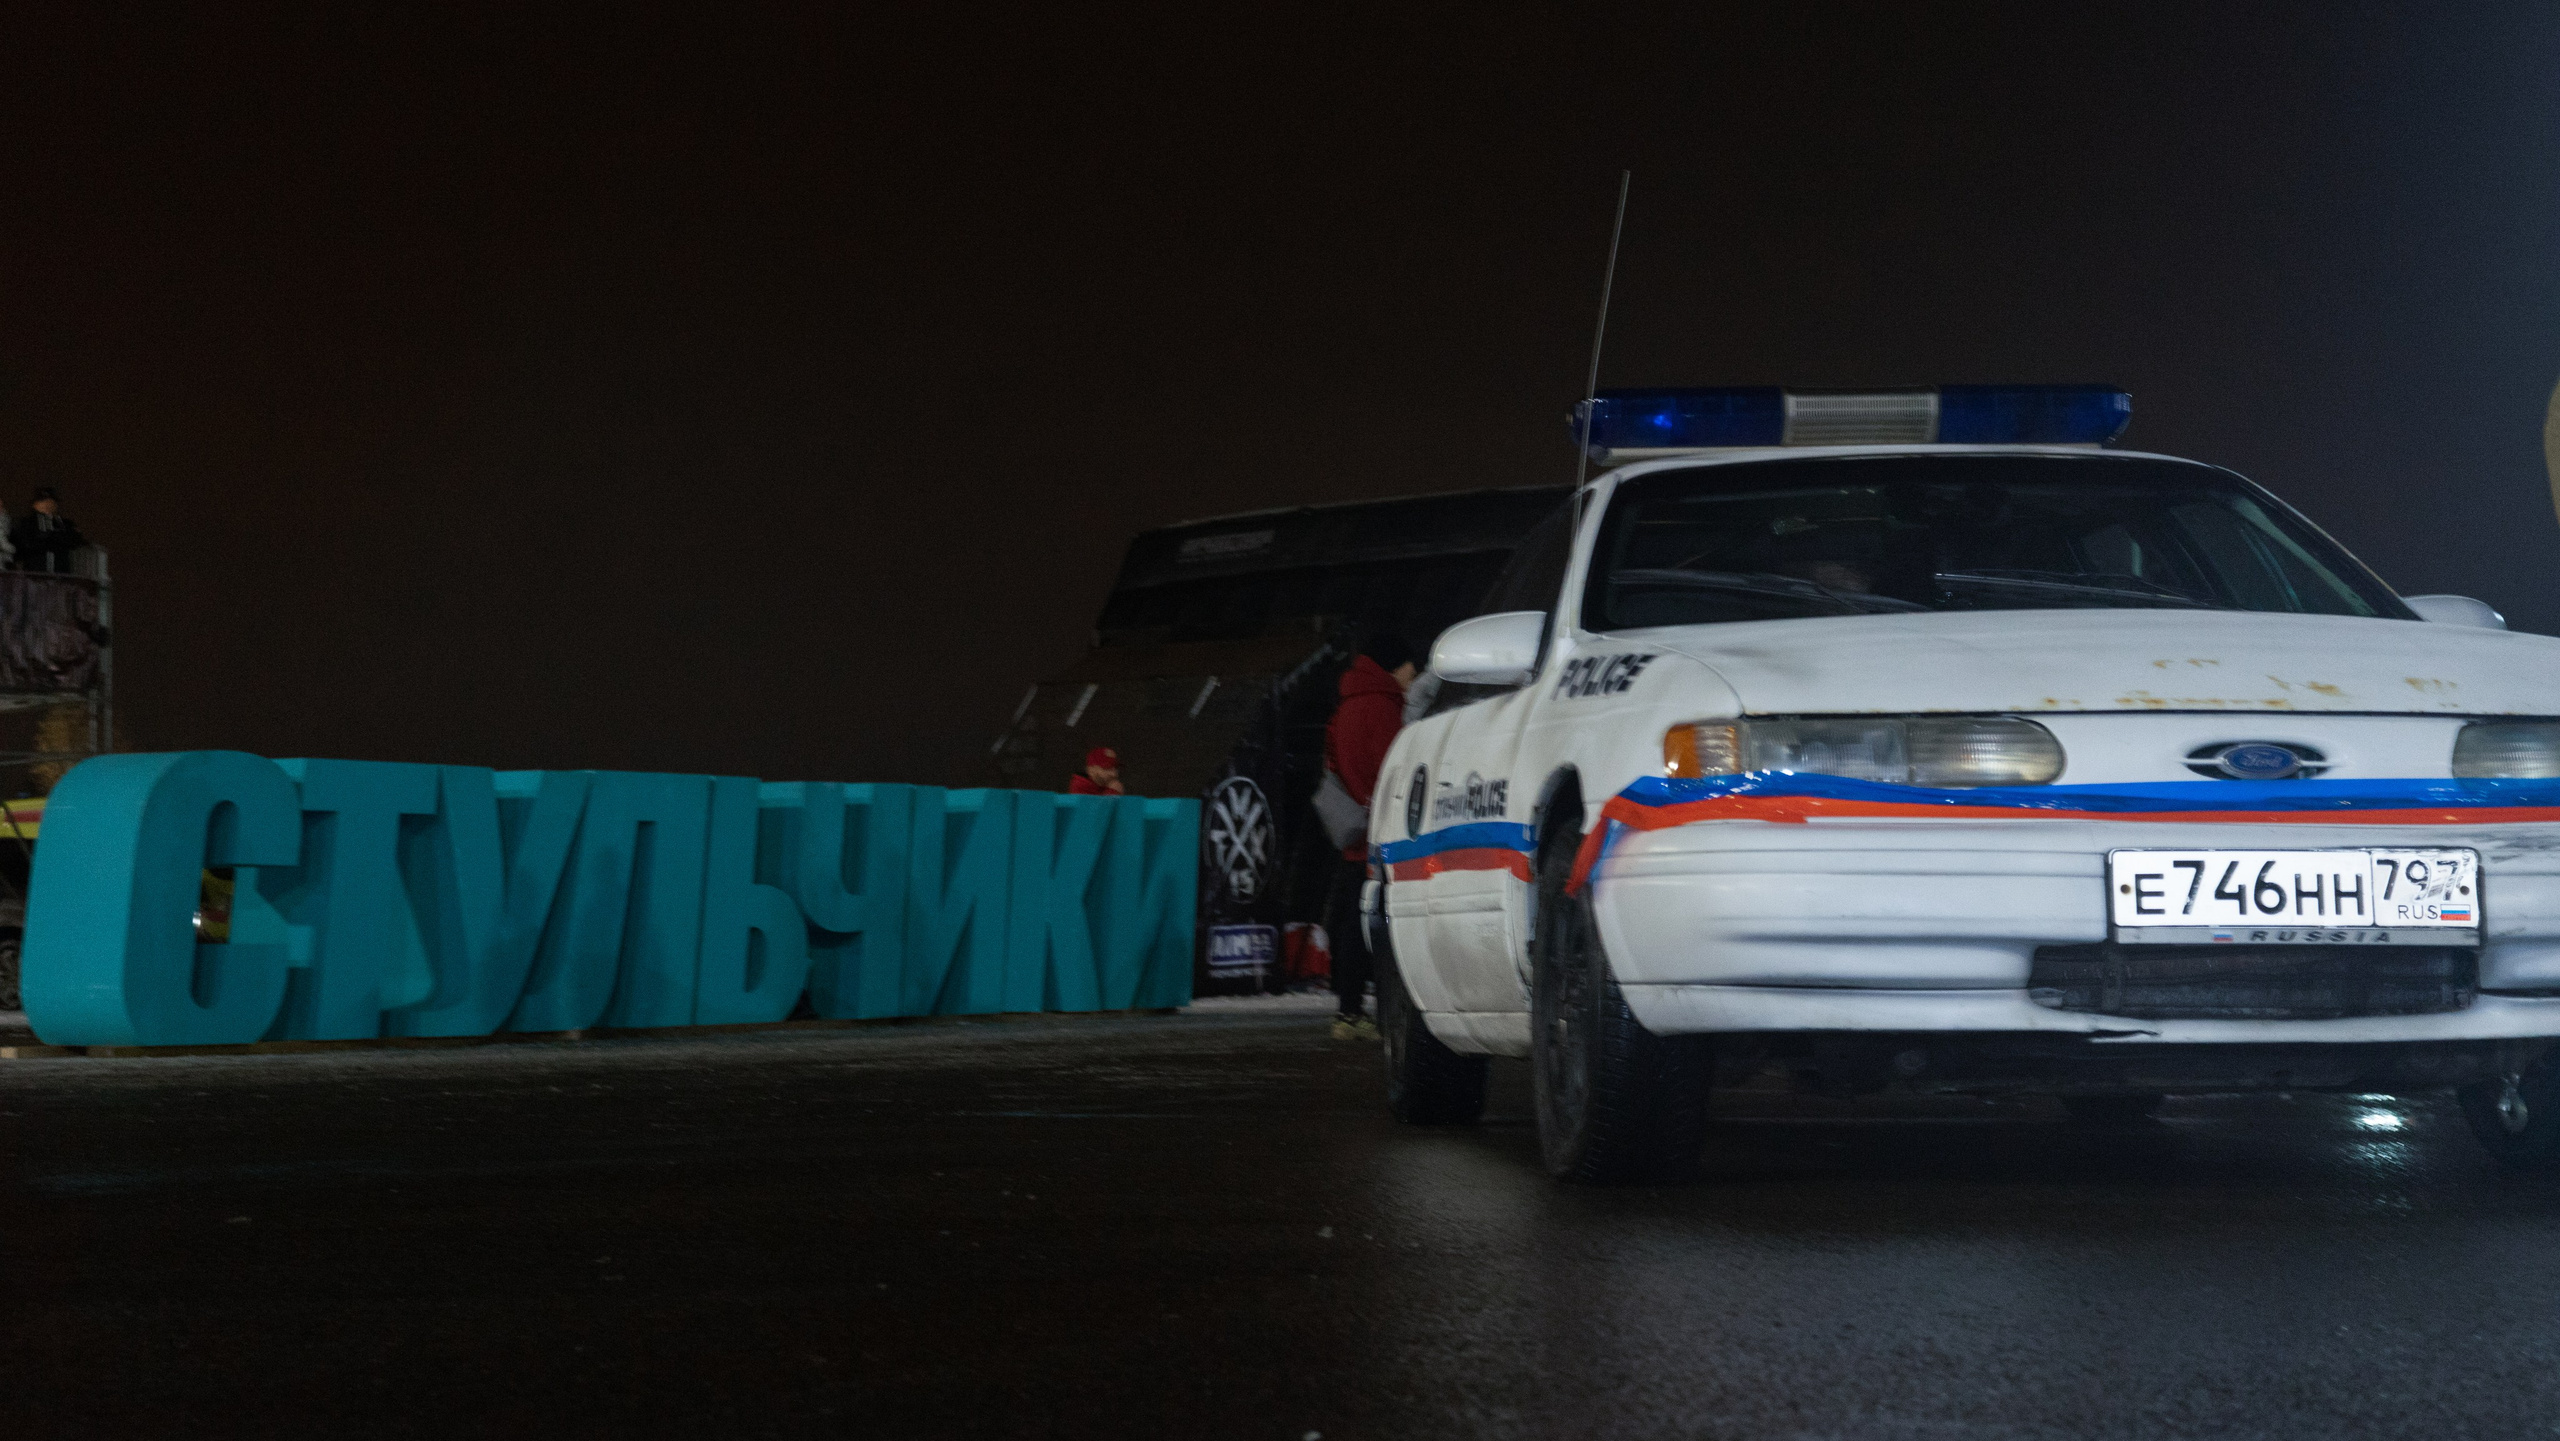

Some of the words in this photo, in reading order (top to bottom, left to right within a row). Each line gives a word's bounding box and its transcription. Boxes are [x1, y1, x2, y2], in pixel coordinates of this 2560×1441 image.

[1550, 653, 1658, 700] POLICE
[20, 750, 1200, 1047] СТУЛЬЧИКИ
[2397, 904, 2439, 920] RUS
[2250, 930, 2391, 943] RUSSIA
